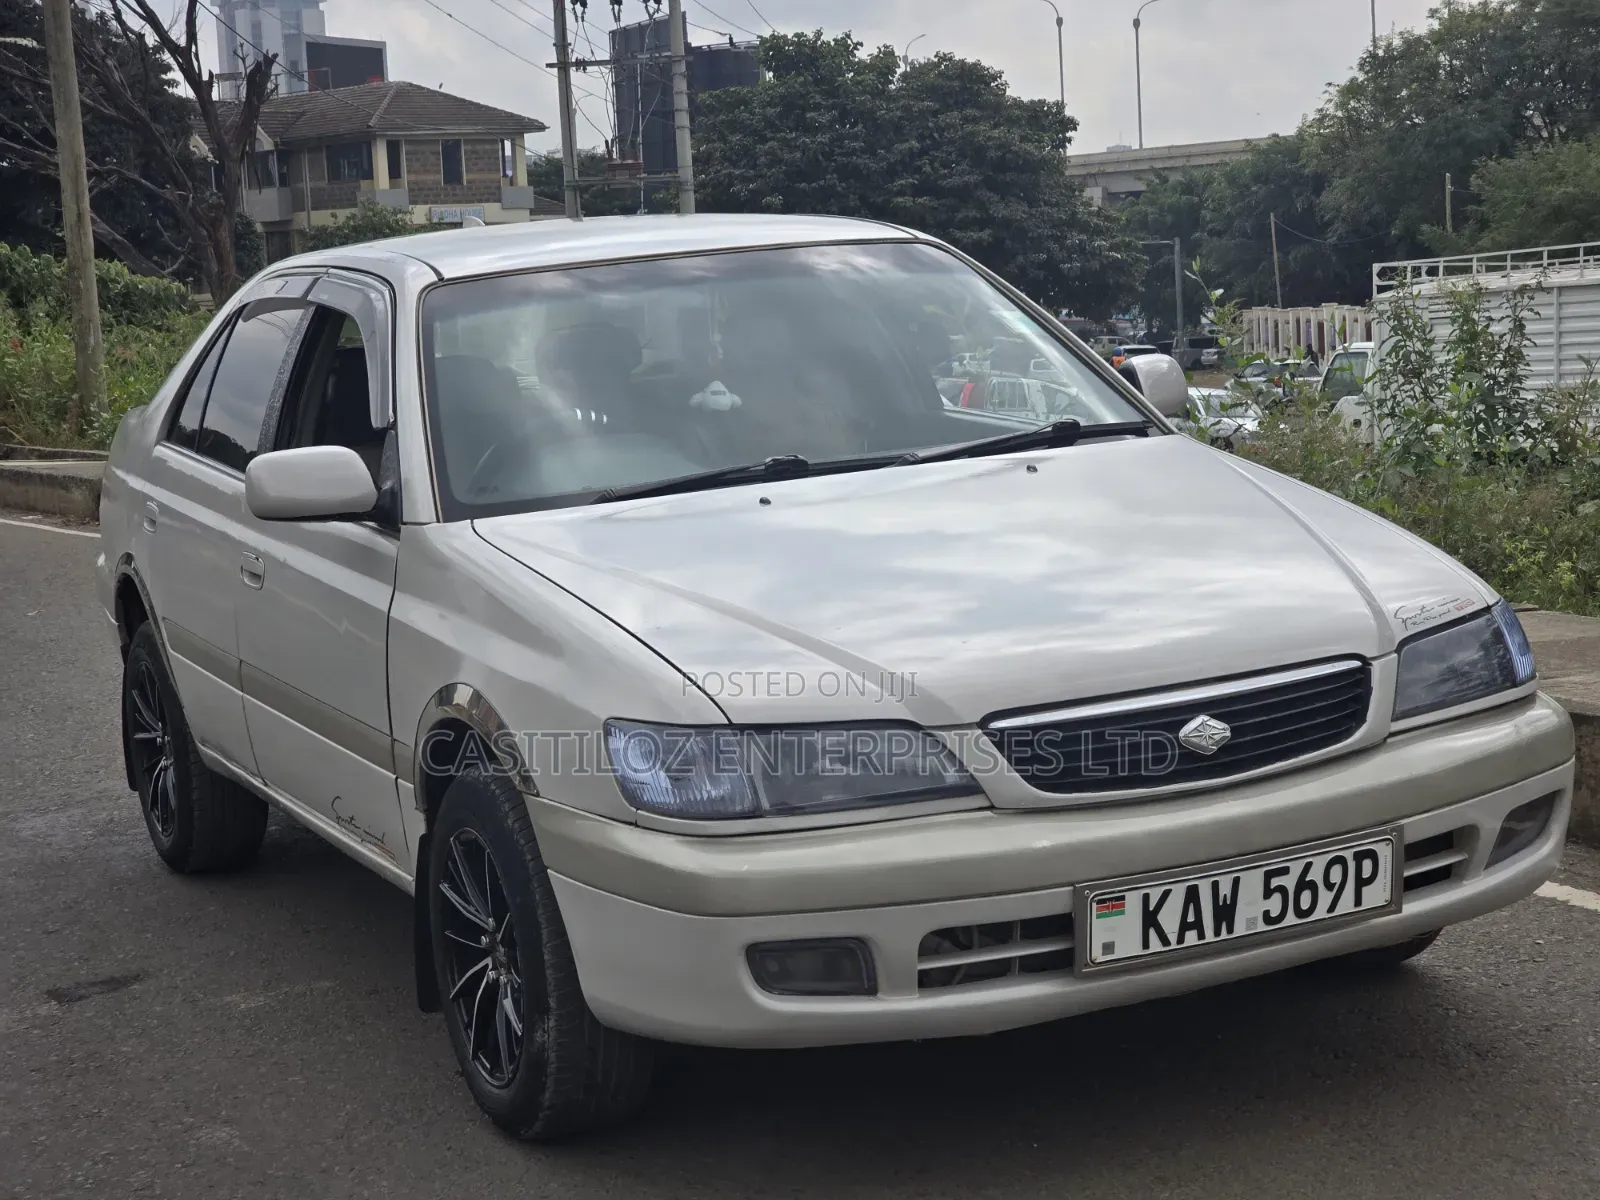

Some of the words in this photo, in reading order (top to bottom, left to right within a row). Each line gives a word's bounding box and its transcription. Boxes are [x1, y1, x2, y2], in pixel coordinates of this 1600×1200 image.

[432, 208, 458, 219] RIDHA
[1141, 875, 1241, 950] KAW
[1262, 847, 1380, 926] 569P
